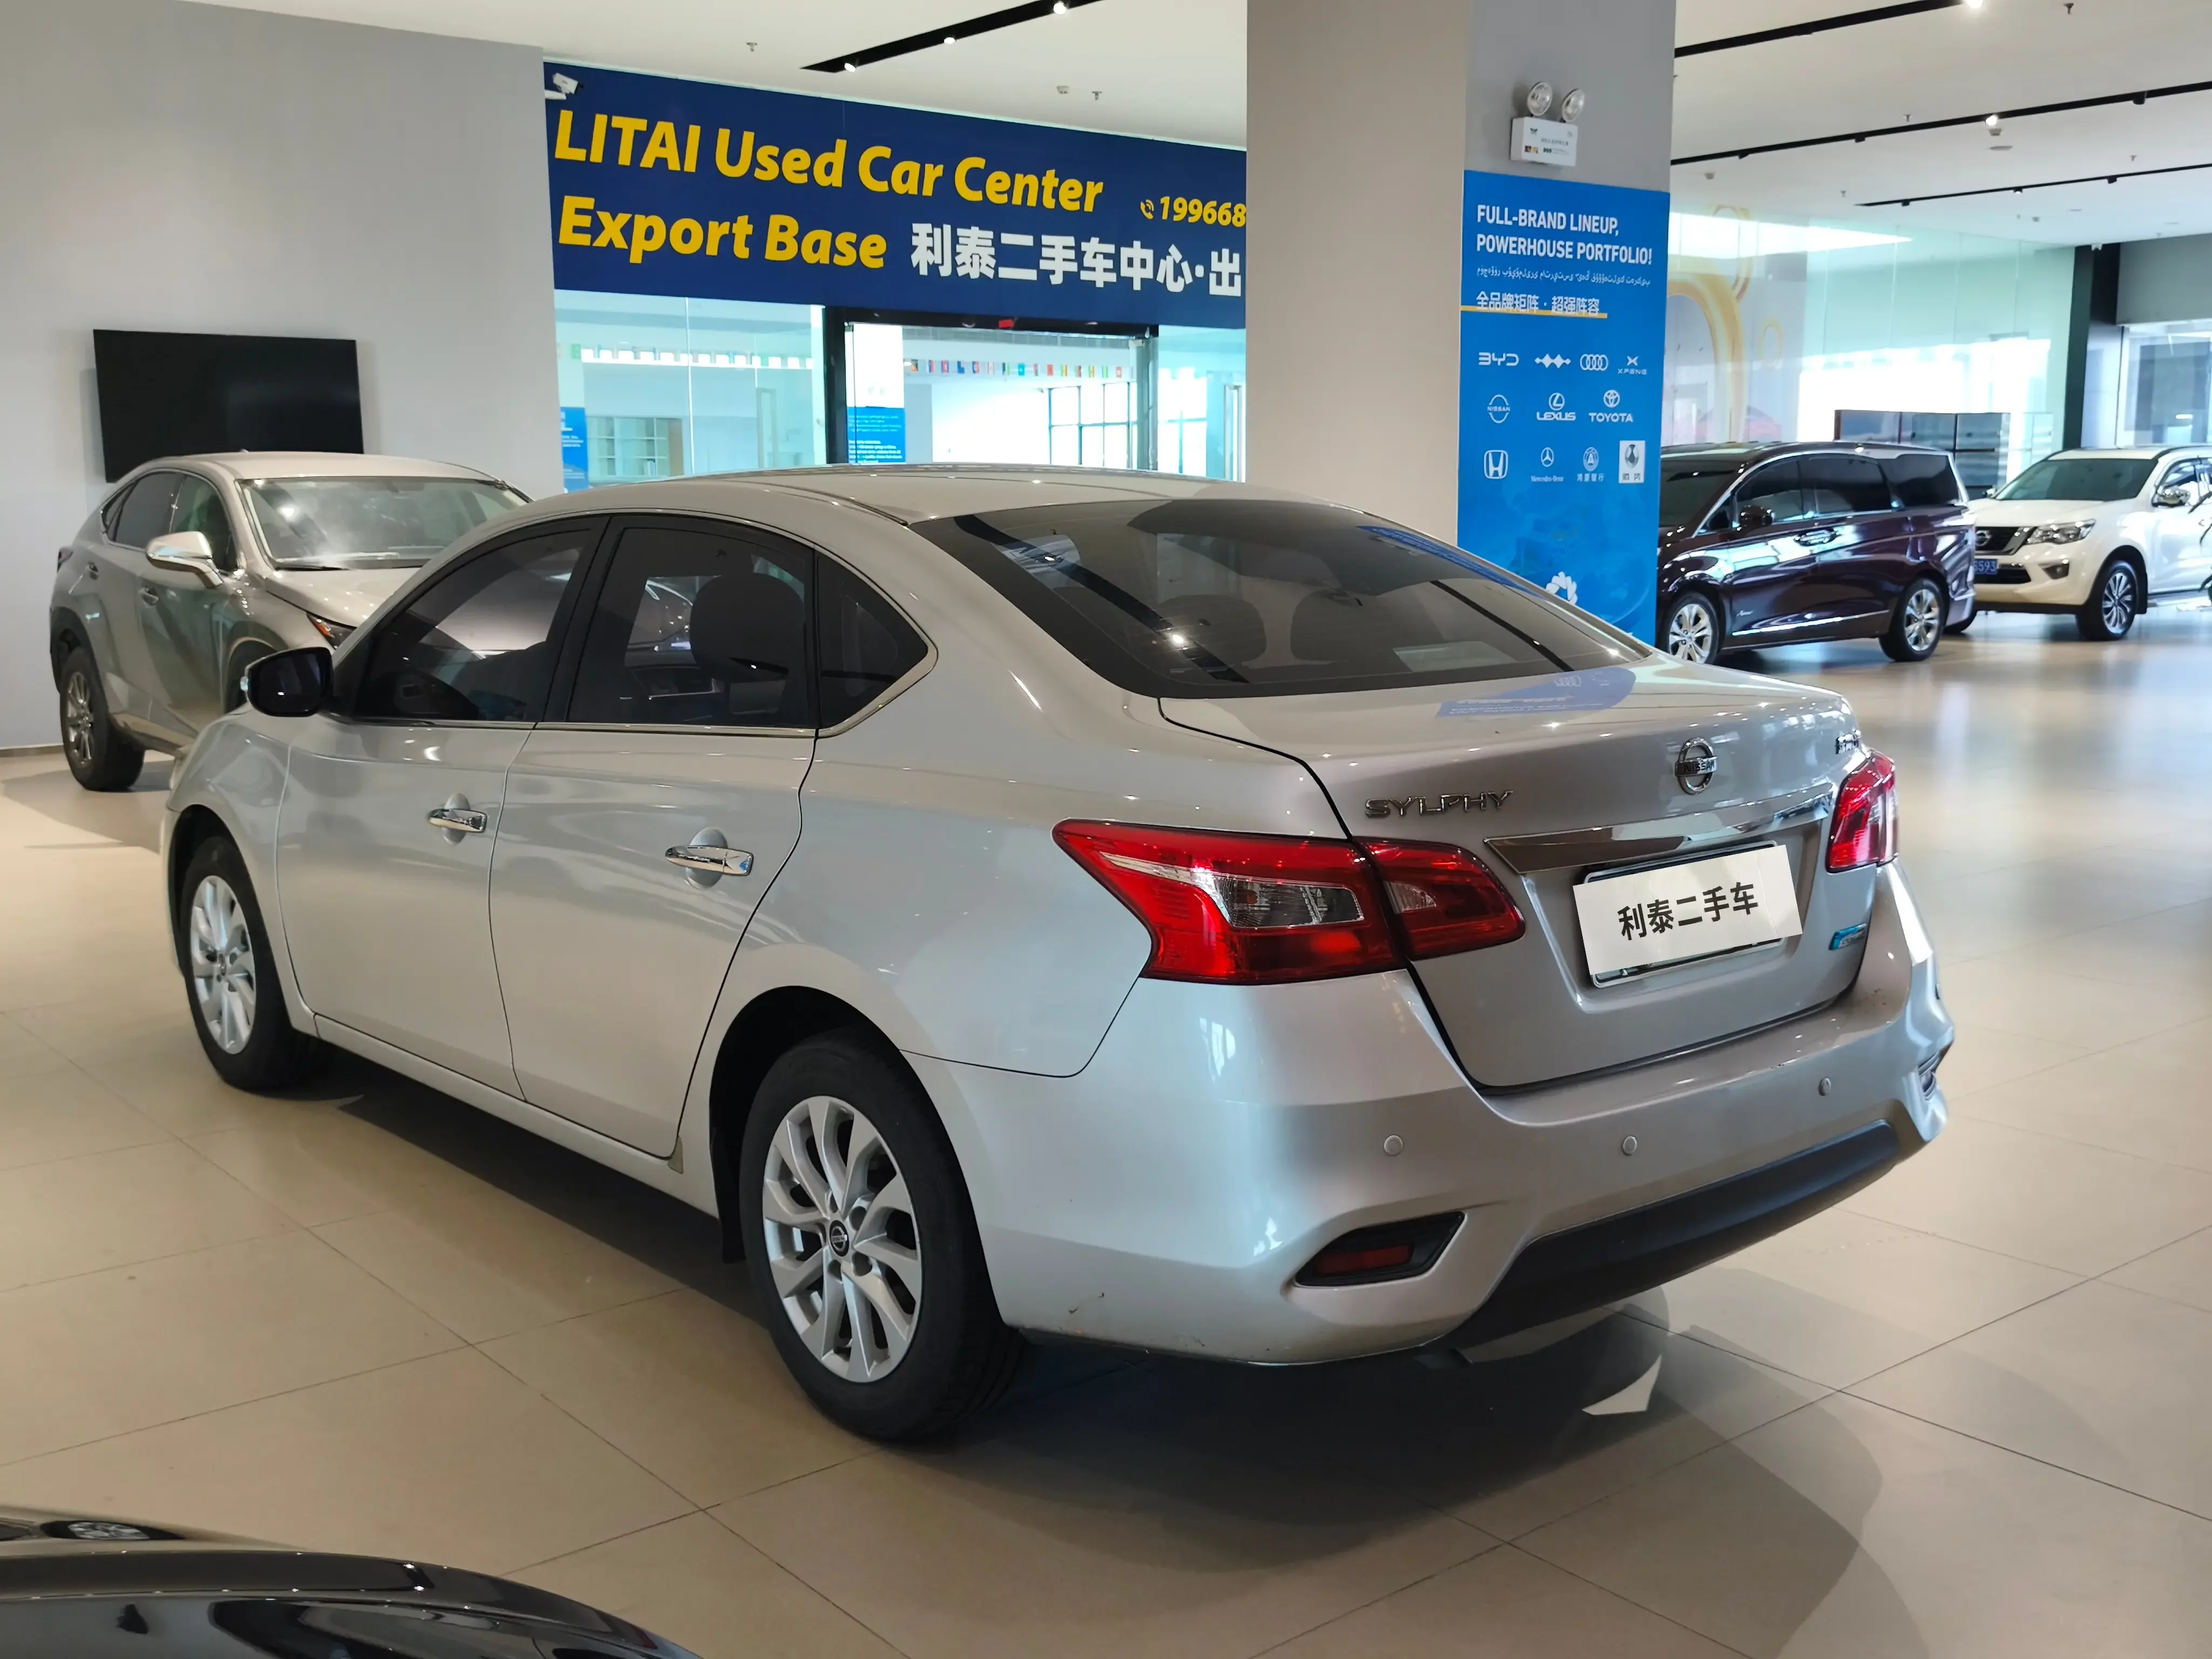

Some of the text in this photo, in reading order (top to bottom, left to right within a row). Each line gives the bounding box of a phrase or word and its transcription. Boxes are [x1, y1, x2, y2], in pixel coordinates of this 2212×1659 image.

[555, 110, 1103, 212] LITAI Used Car Center
[1160, 196, 1246, 227] 199668
[1477, 204, 1618, 237] FULL-BRAND LINEUP,
[558, 195, 887, 268] Export Base
[1476, 234, 1653, 265] POWERHOUSE PORTFOLIO!
[1478, 352, 1519, 366] BYD
[1536, 412, 1576, 421] LEXUS
[1588, 413, 1633, 422] TOYOTA
[1365, 791, 1513, 818] SYLPHY
[1617, 881, 1758, 941] 利泰二手车
